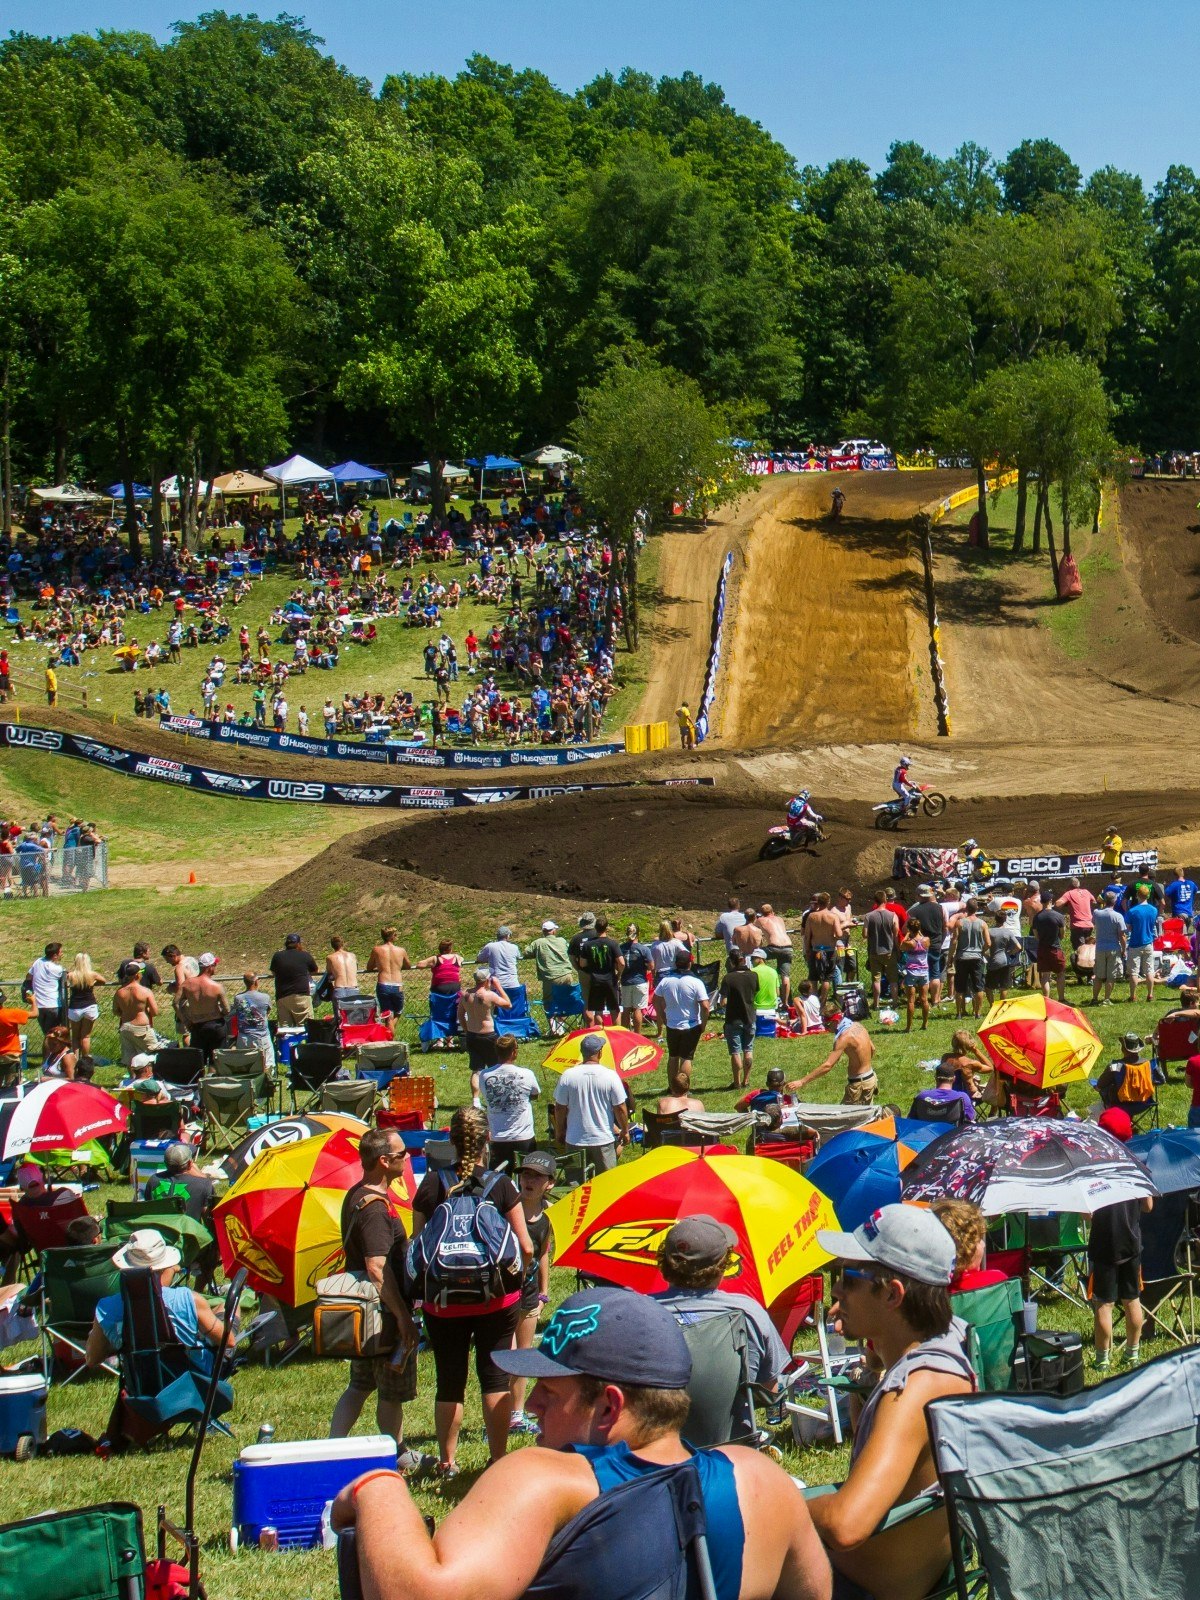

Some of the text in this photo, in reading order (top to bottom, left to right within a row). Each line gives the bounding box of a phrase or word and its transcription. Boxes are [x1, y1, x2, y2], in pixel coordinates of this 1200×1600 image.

[171, 717, 190, 726] LUCAS
[6, 726, 63, 750] WPS
[230, 729, 270, 743] Husqvarna
[72, 738, 130, 761] FLY
[289, 739, 328, 752] Husqvarna
[347, 747, 387, 757] Husqvarna
[150, 758, 170, 769] LUCAS
[520, 754, 559, 763] Husqvarna
[136, 763, 192, 782] MOTOCROSS
[202, 771, 261, 789] FLY
[268, 780, 325, 801] WPS
[332, 787, 392, 799] FLY
[462, 790, 521, 803] FLY
[400, 797, 454, 806] MOTOCROSS
[1007, 857, 1061, 874] GEICO
[571, 1185, 592, 1235] POWER
[767, 1232, 794, 1275] FEEL
